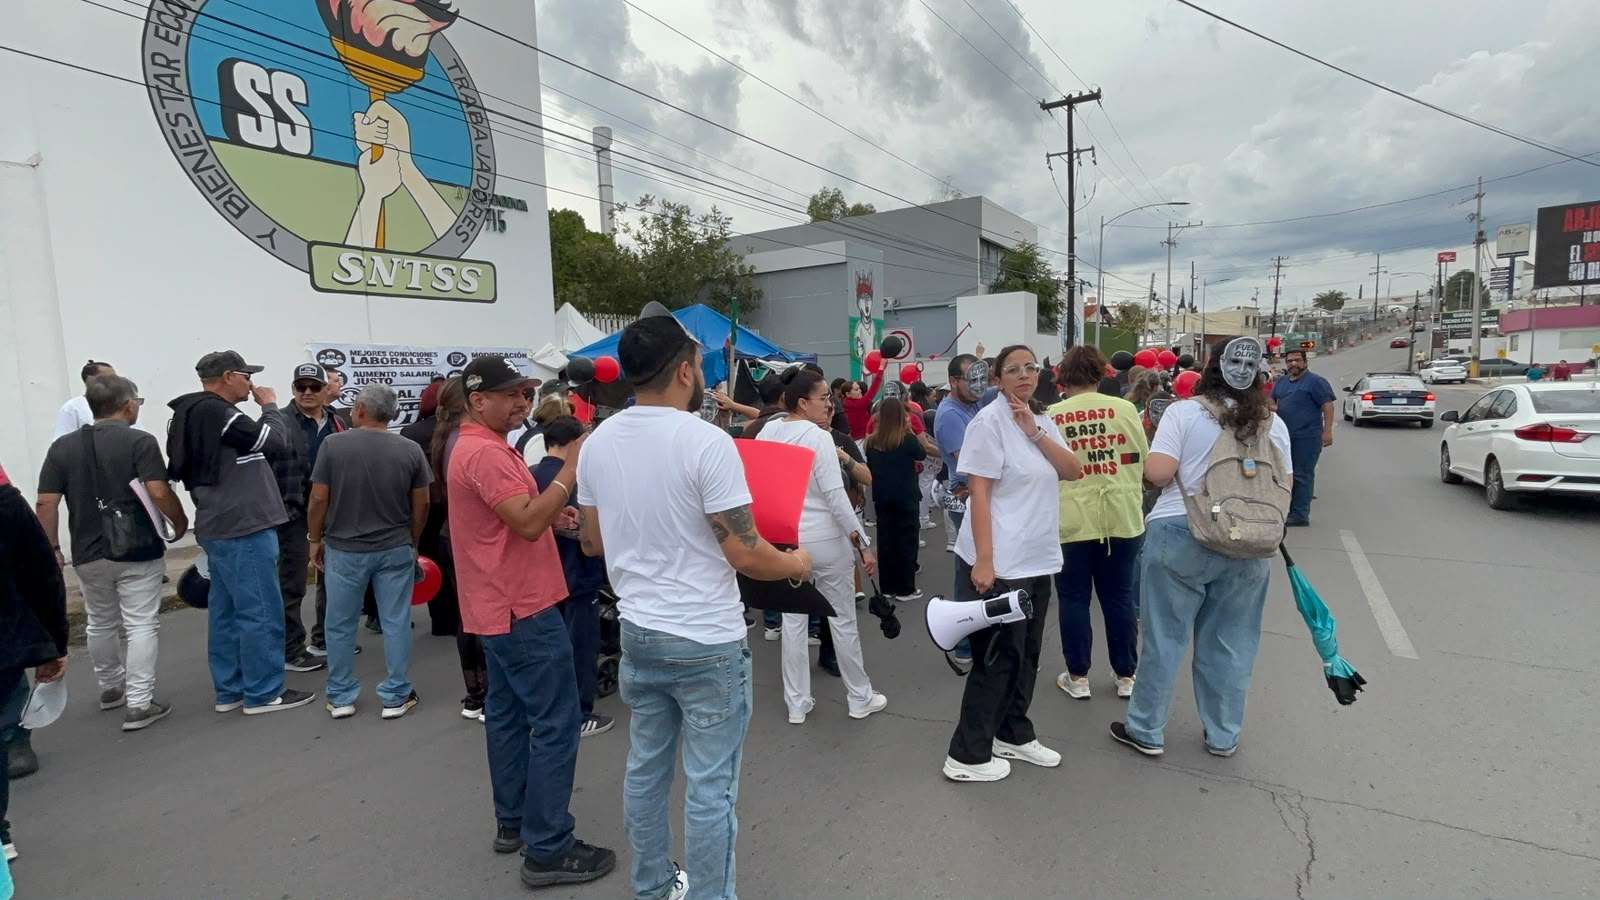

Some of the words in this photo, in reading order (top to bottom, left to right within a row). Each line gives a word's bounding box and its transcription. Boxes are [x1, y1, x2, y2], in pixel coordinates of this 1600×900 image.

[232, 60, 313, 156] SS
[151, 52, 250, 221] BIENESTAR
[447, 58, 492, 244] TRABAJADORES
[256, 227, 279, 250] Y
[1570, 244, 1581, 263] EL
[331, 252, 484, 295] SNTSS
[351, 357, 433, 365] LABORALES
[354, 377, 393, 385] JUSTO
[1051, 407, 1116, 426] RABAJO
[1065, 422, 1107, 438] BAJO
[1067, 433, 1127, 452] OTESTA
[1087, 449, 1115, 463] HAY
